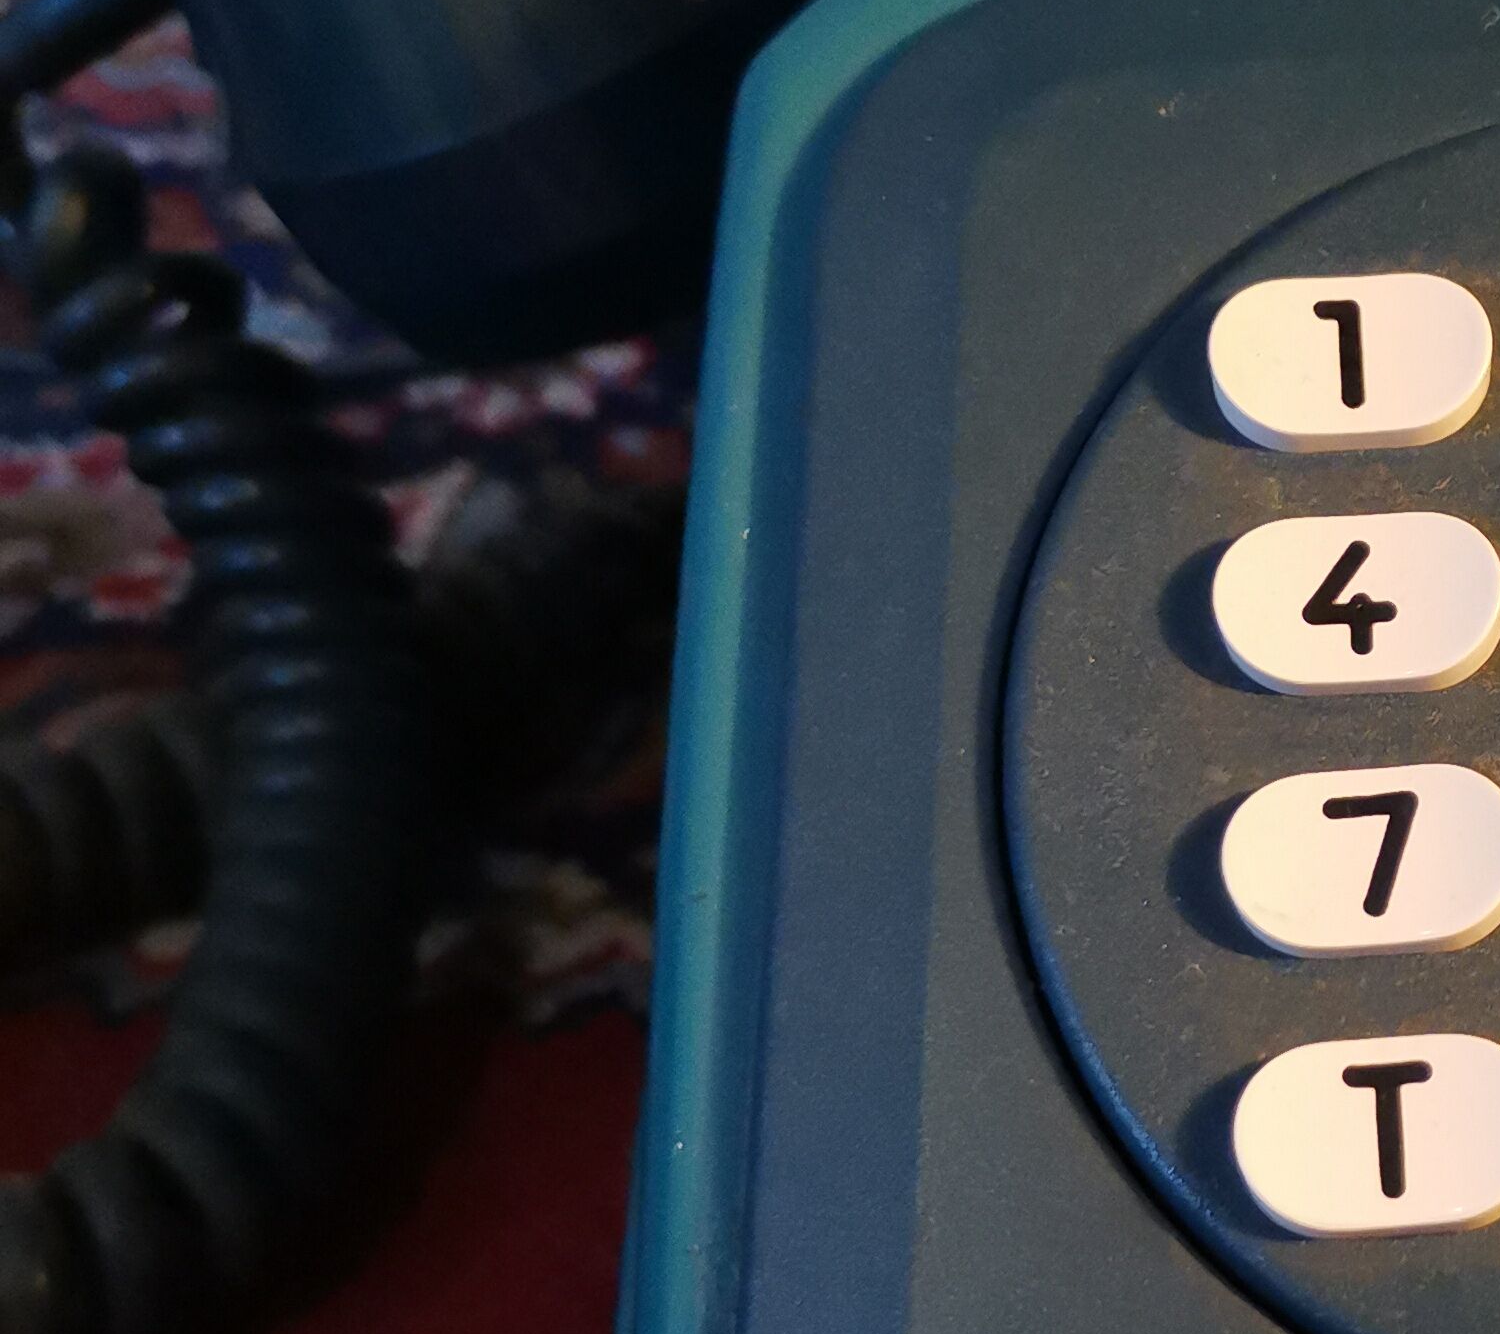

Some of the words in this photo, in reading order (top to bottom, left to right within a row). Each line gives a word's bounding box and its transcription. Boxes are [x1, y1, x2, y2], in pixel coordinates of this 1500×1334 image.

[1313, 300, 1365, 409] 1
[1302, 540, 1397, 654] 4
[1323, 792, 1417, 916] 7
[1342, 1062, 1431, 1198] T
